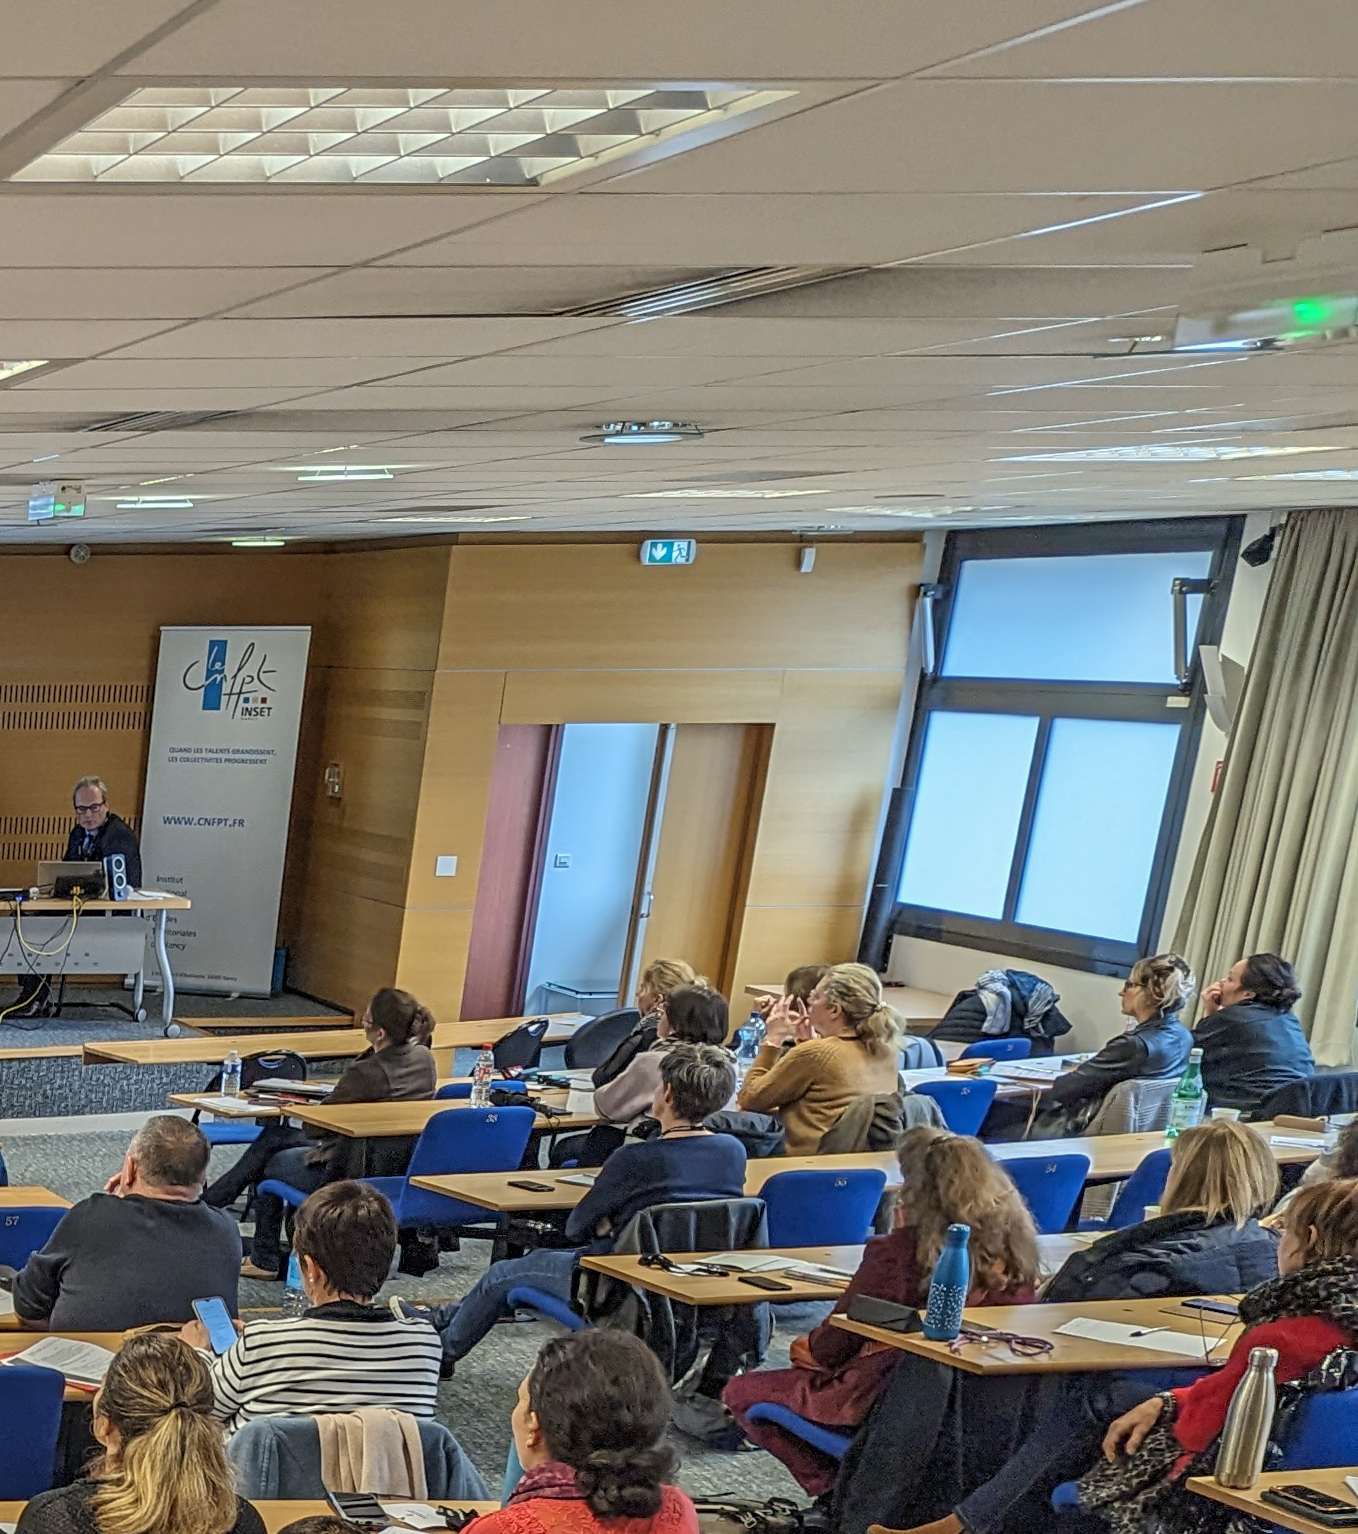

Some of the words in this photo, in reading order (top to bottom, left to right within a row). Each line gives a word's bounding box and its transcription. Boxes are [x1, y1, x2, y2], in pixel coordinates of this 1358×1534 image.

[241, 706, 273, 717] INSET
[162, 816, 245, 828] WWW.CNFPT.FR
[156, 876, 183, 884] Institut
[6, 1216, 20, 1226] 57
